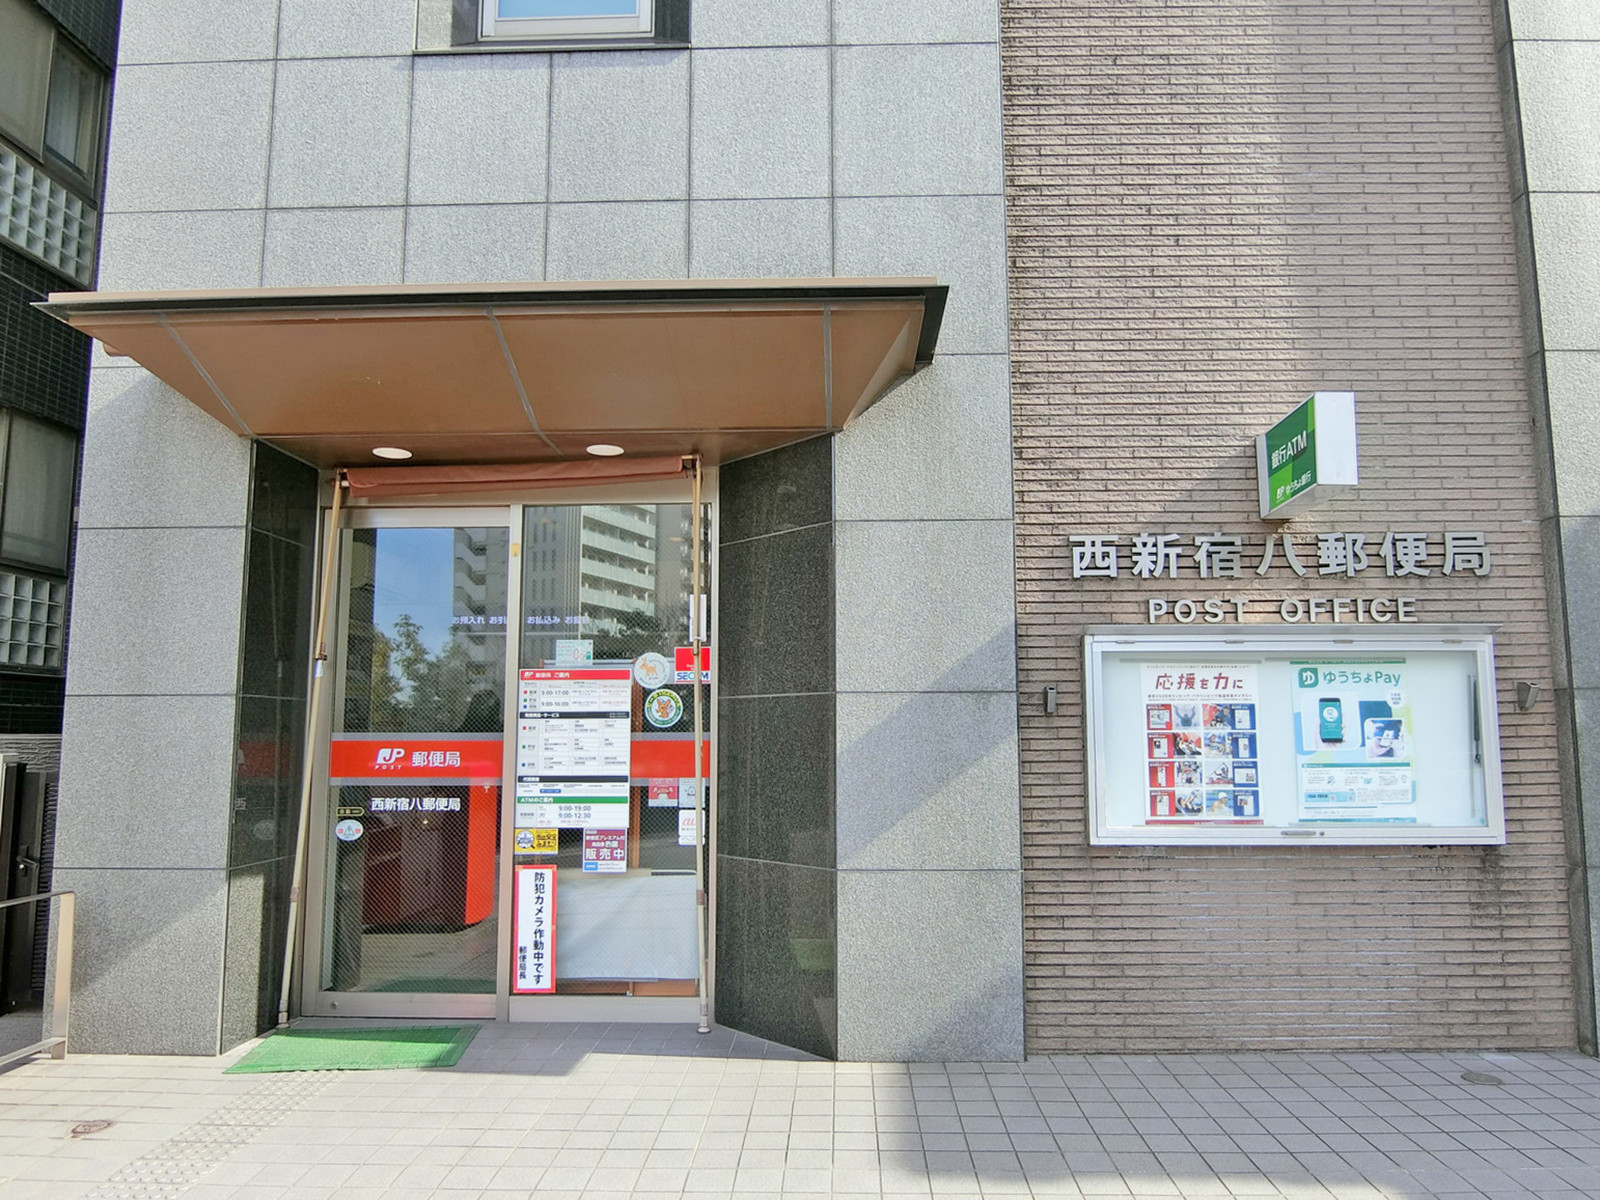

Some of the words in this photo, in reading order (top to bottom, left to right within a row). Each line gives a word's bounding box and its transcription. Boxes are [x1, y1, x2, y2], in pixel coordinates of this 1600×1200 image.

[1271, 430, 1307, 469] 銀行ATM
[1069, 532, 1491, 578] 西新宿八郵便局
[1148, 598, 1250, 624] POST
[1280, 597, 1418, 623] OFFICE
[676, 671, 709, 680] SECM
[1155, 672, 1243, 690] 応援を力に
[1322, 670, 1401, 687] ゆうちょPay
[411, 751, 461, 767] 郵便局
[370, 797, 461, 812] 西新宿八郵便局
[585, 848, 625, 860] 販売中
[533, 872, 545, 985] 防犯カメラ作動中です
